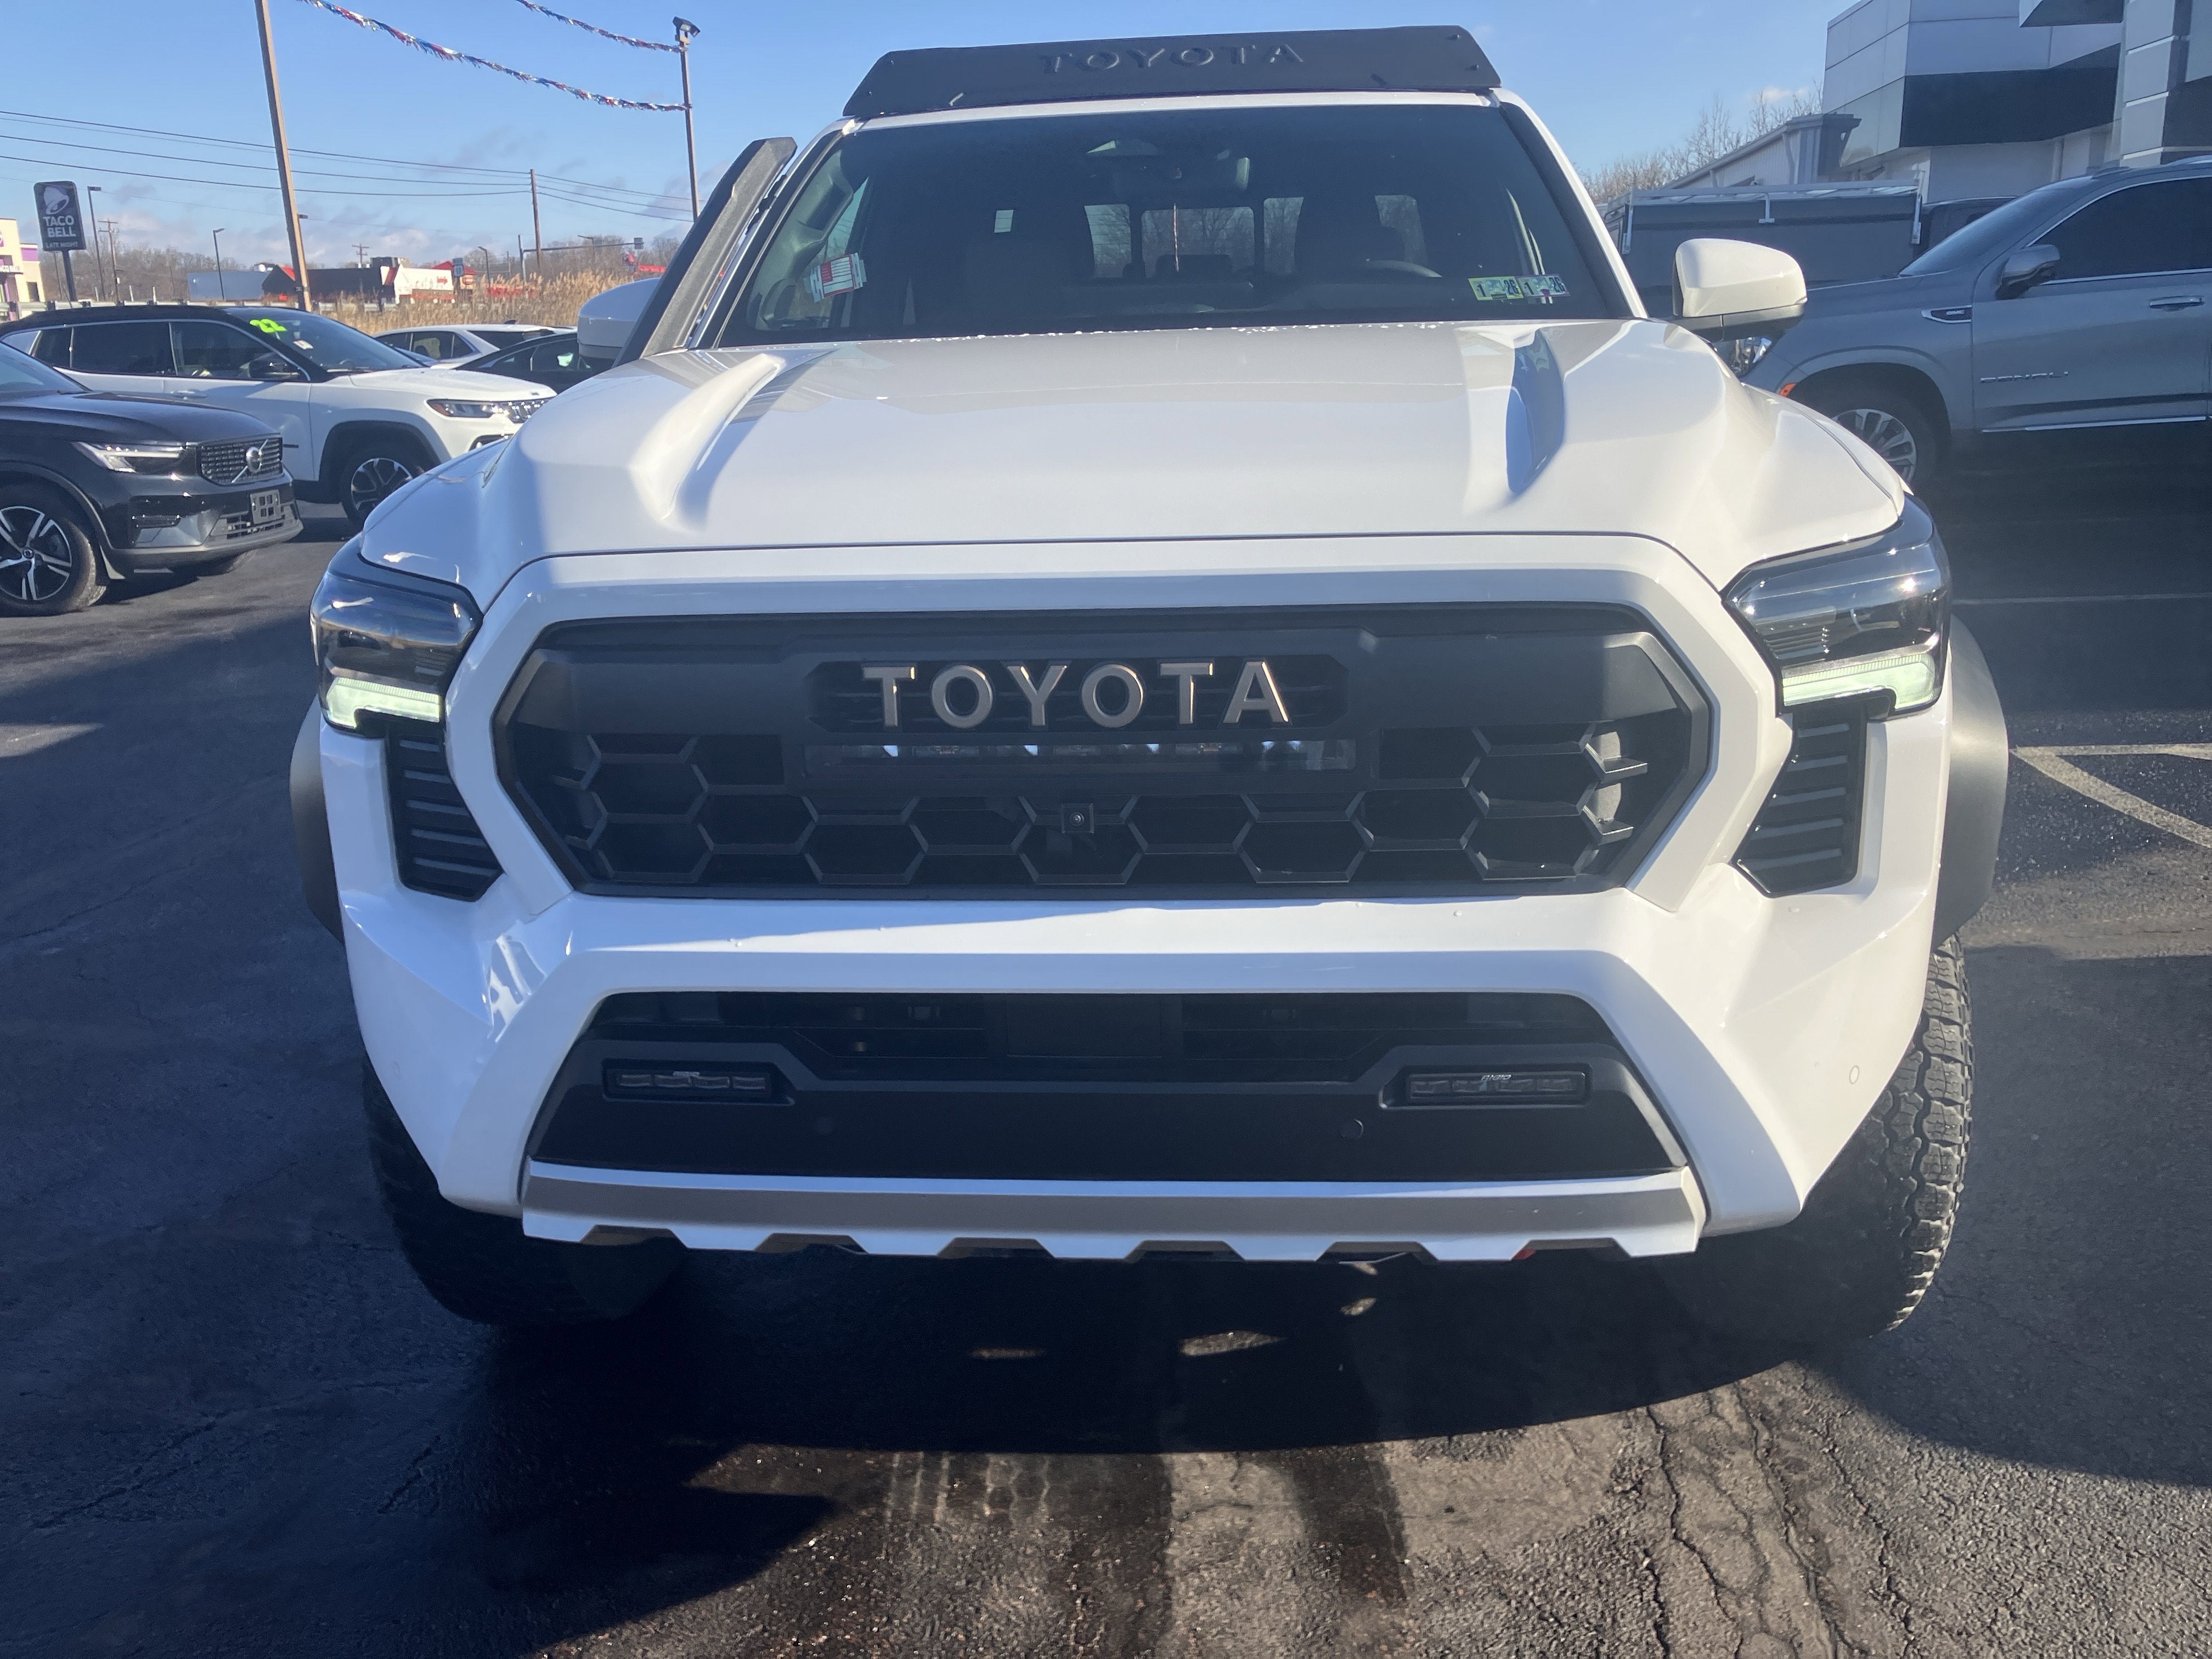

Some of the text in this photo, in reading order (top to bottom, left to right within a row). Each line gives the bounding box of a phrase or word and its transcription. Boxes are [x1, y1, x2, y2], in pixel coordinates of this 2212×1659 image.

[1038, 43, 1305, 74] TOYOTA
[43, 215, 74, 227] TACO
[47, 227, 76, 237] BELL
[1477, 284, 1486, 297] 1
[1504, 280, 1519, 294] 26
[1524, 276, 1565, 295] 1 26
[1980, 371, 2069, 383] DENALI
[862, 660, 1290, 729] TOYOTA
